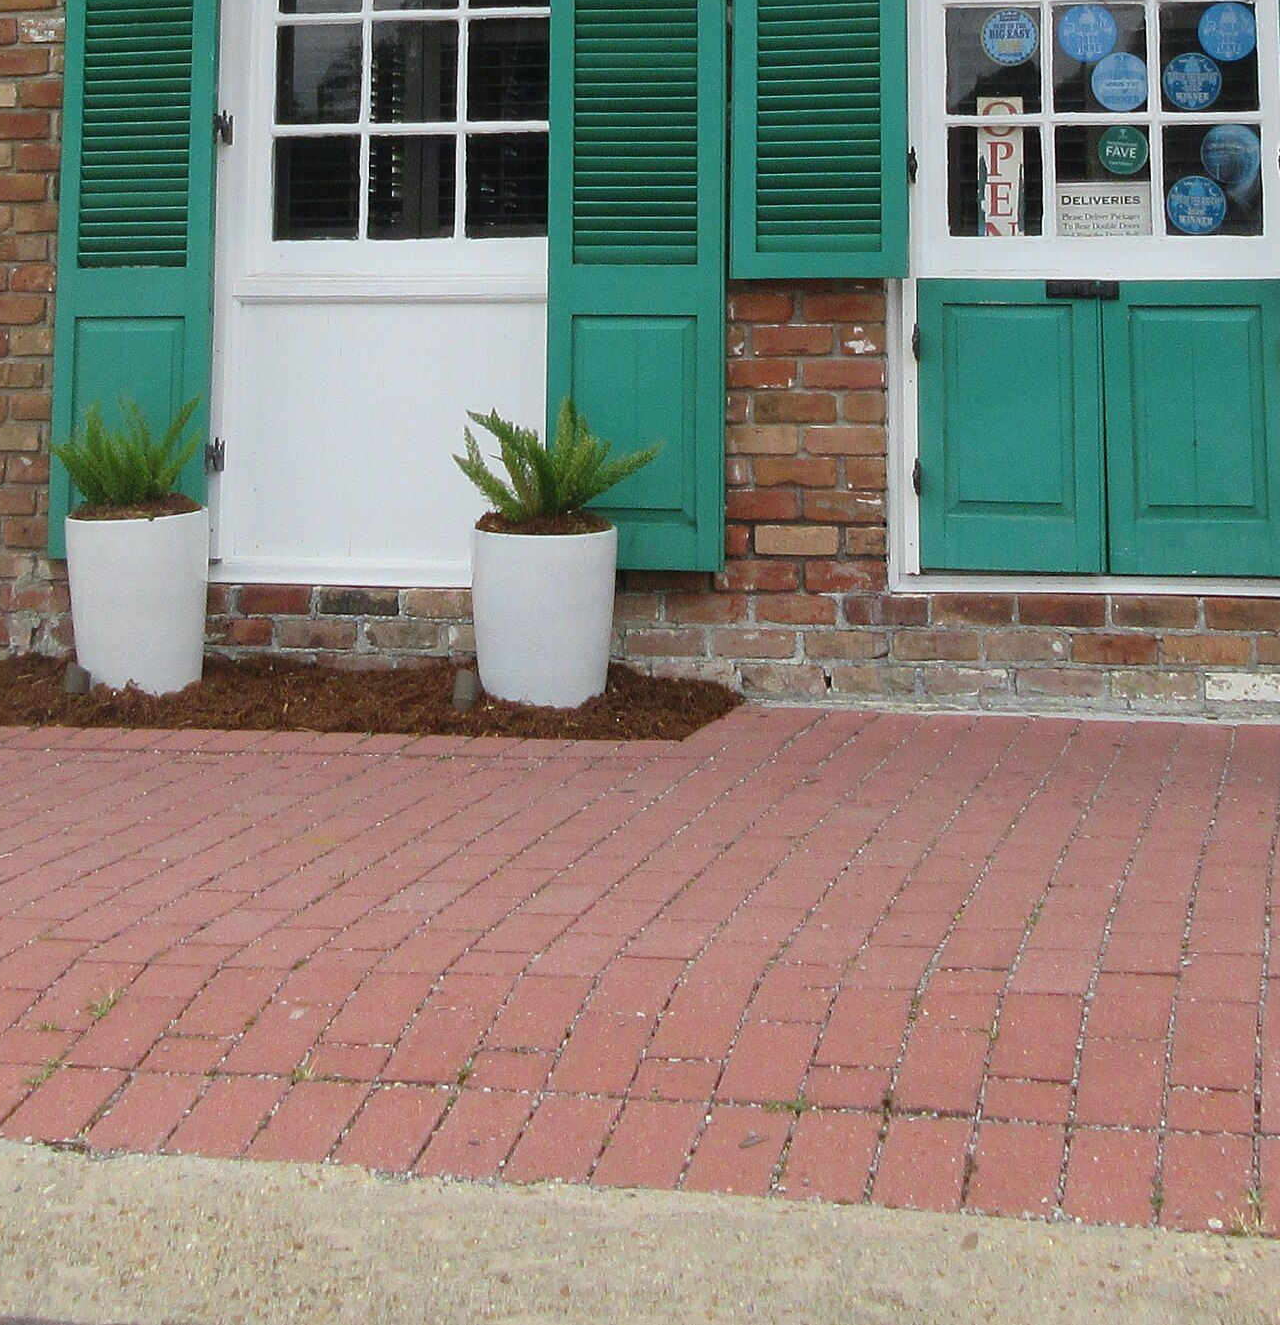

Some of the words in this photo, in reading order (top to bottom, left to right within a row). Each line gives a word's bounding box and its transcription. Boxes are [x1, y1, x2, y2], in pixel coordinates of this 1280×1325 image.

[989, 29, 1005, 40] BIG
[1007, 29, 1030, 39] EASY
[1106, 146, 1136, 158] FAVE
[1061, 195, 1140, 205] DELIVERIES
[1178, 215, 1213, 226] WINNER
